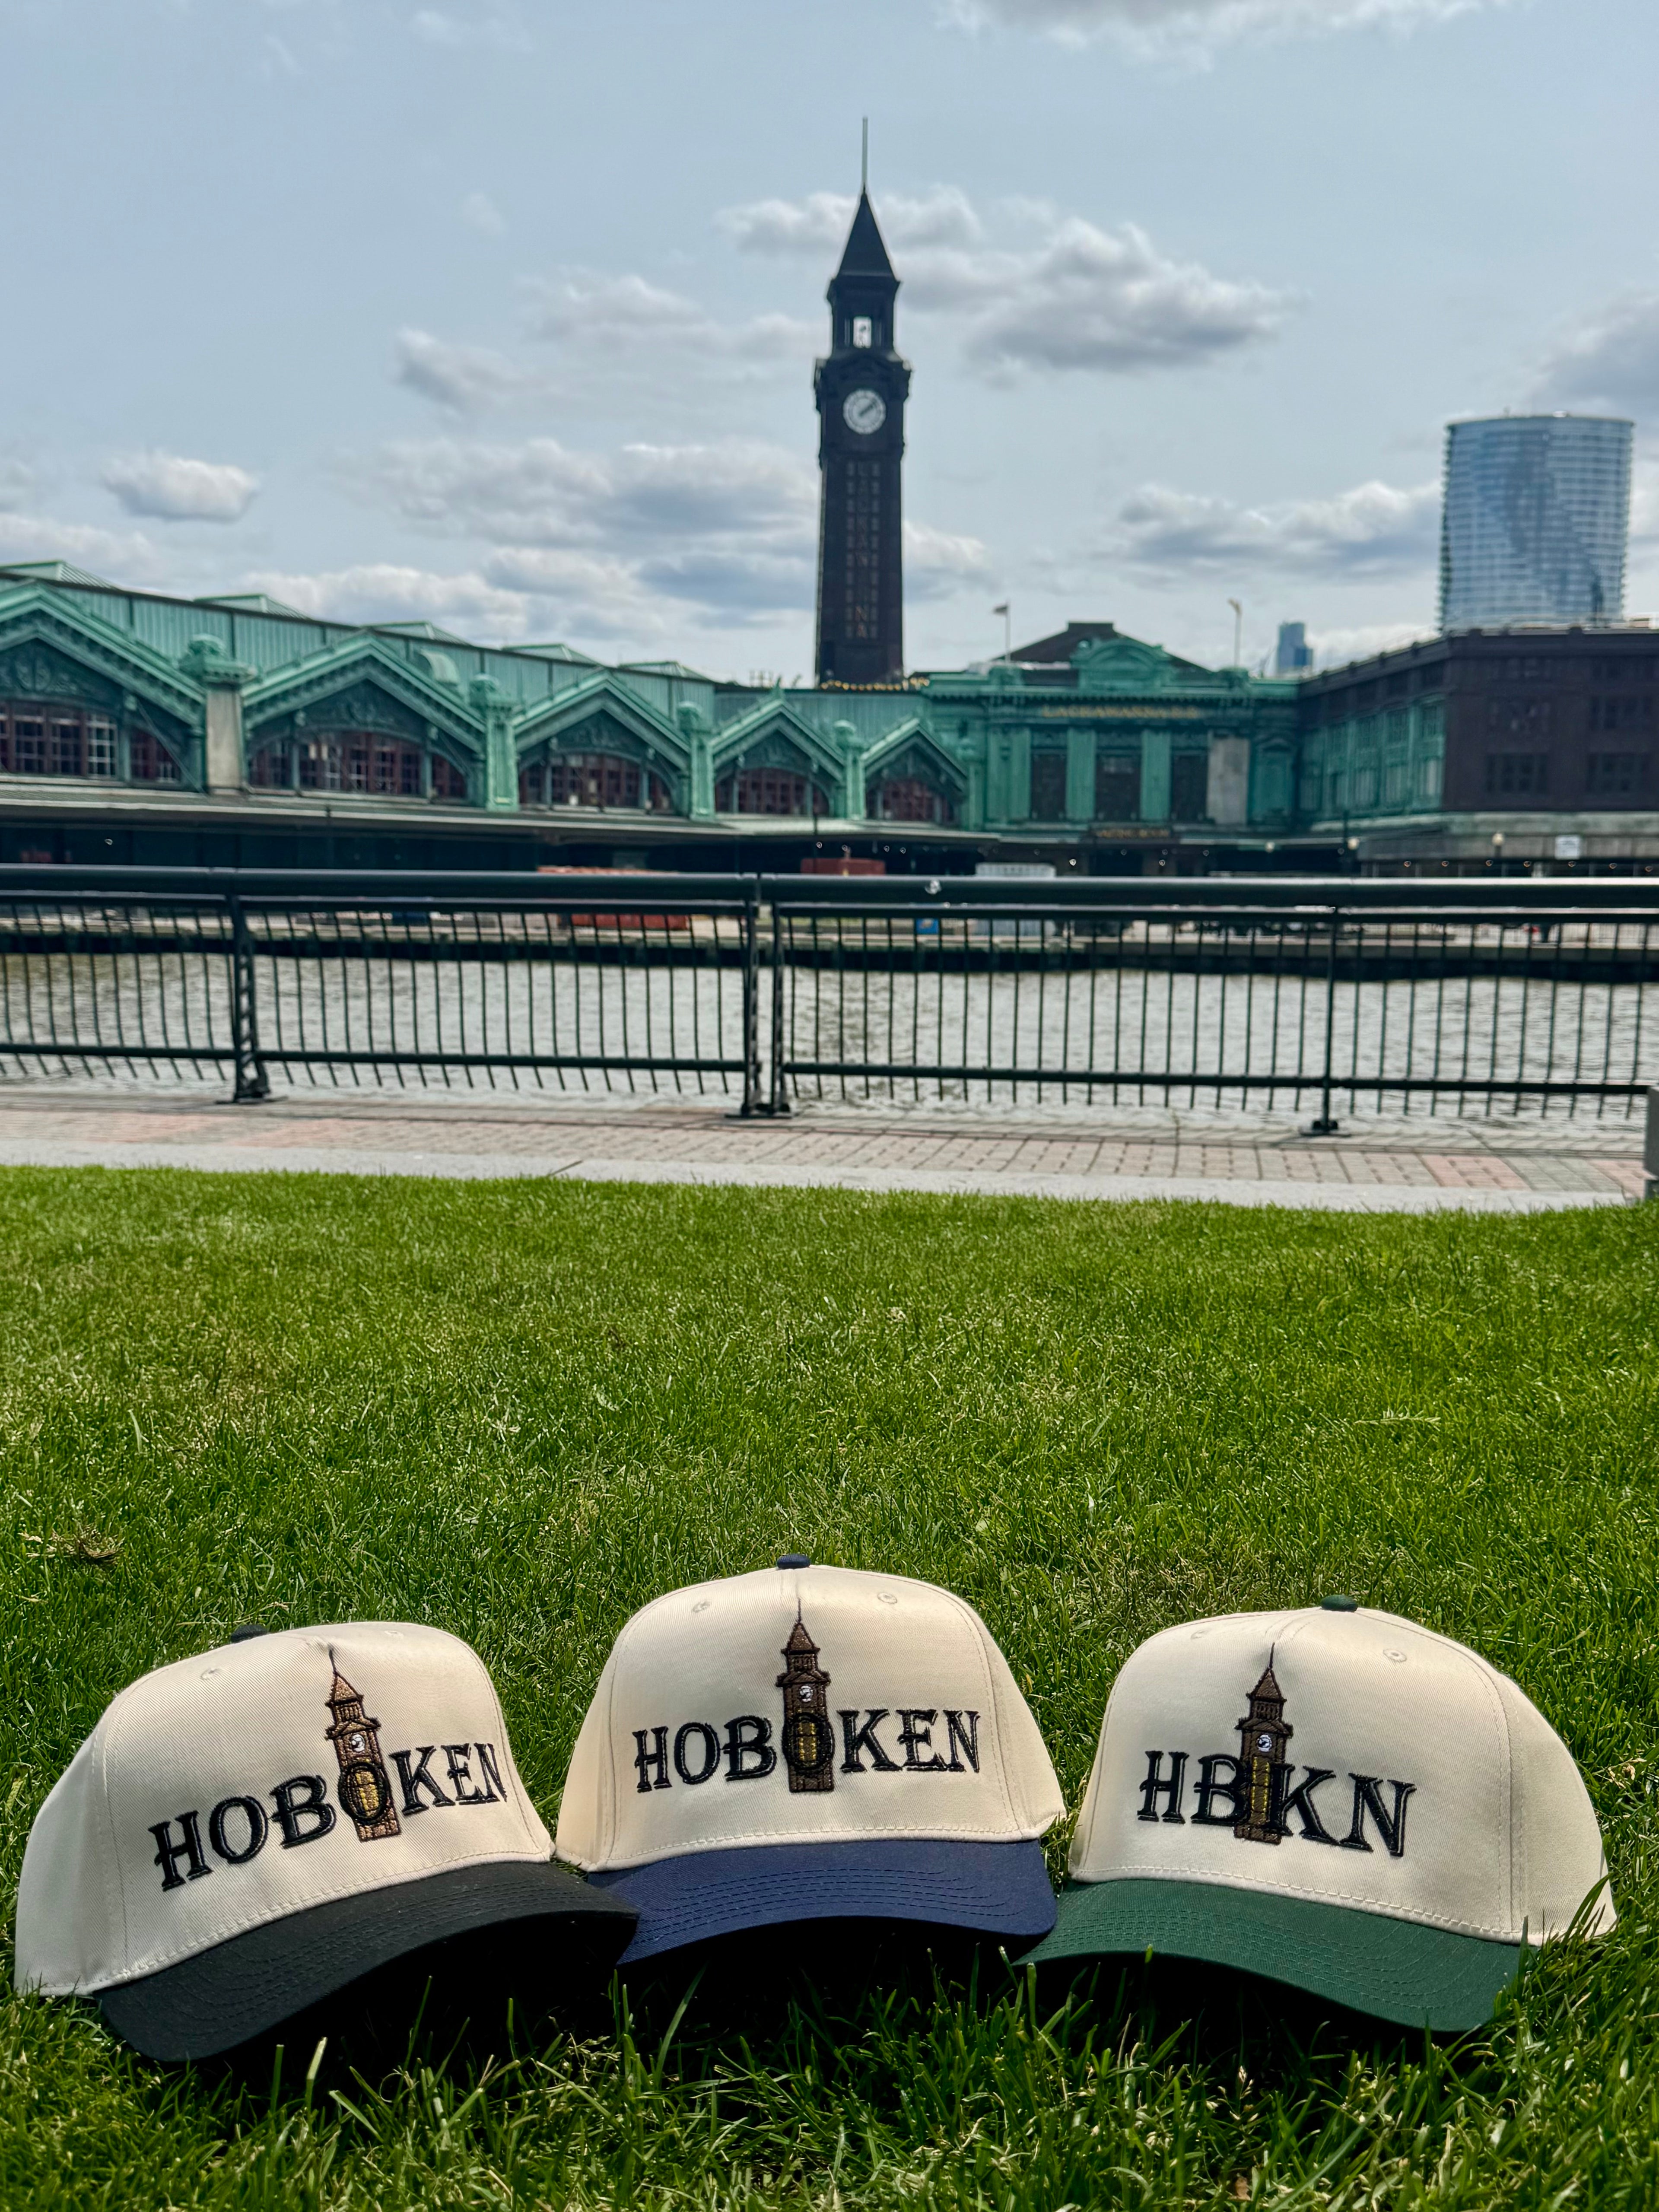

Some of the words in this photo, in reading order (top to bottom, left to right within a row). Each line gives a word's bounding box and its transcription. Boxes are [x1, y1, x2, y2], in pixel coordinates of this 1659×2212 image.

[632, 1709, 981, 1793] HOBOKEN
[1137, 1750, 1417, 1857] HBKN
[148, 1742, 507, 1891] HOBOKEN
